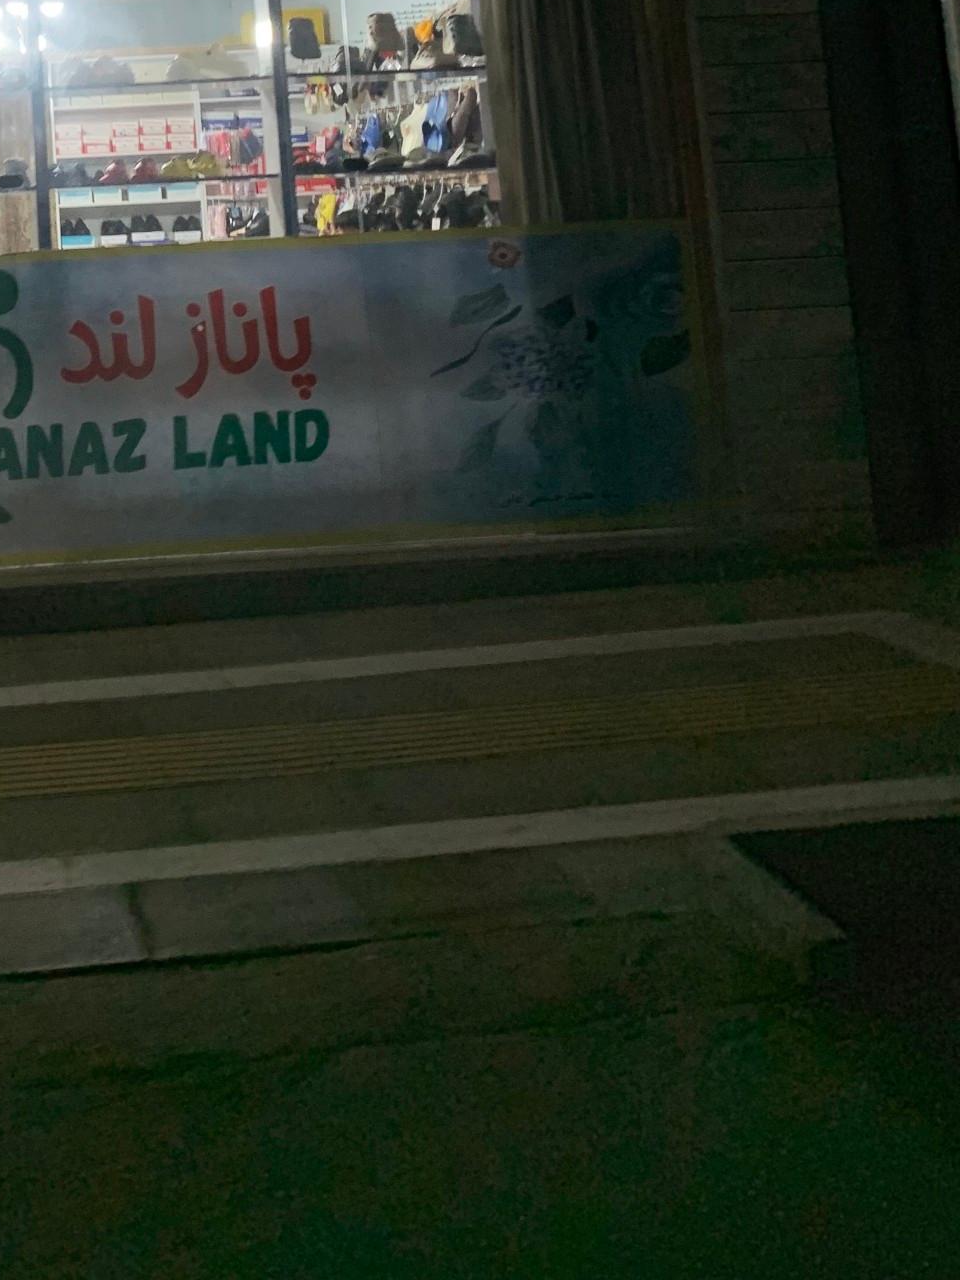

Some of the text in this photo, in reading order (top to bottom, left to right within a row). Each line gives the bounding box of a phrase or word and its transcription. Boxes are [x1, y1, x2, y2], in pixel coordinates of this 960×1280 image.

[60, 285, 318, 401] پاناز لند
[173, 408, 331, 471] LAND
